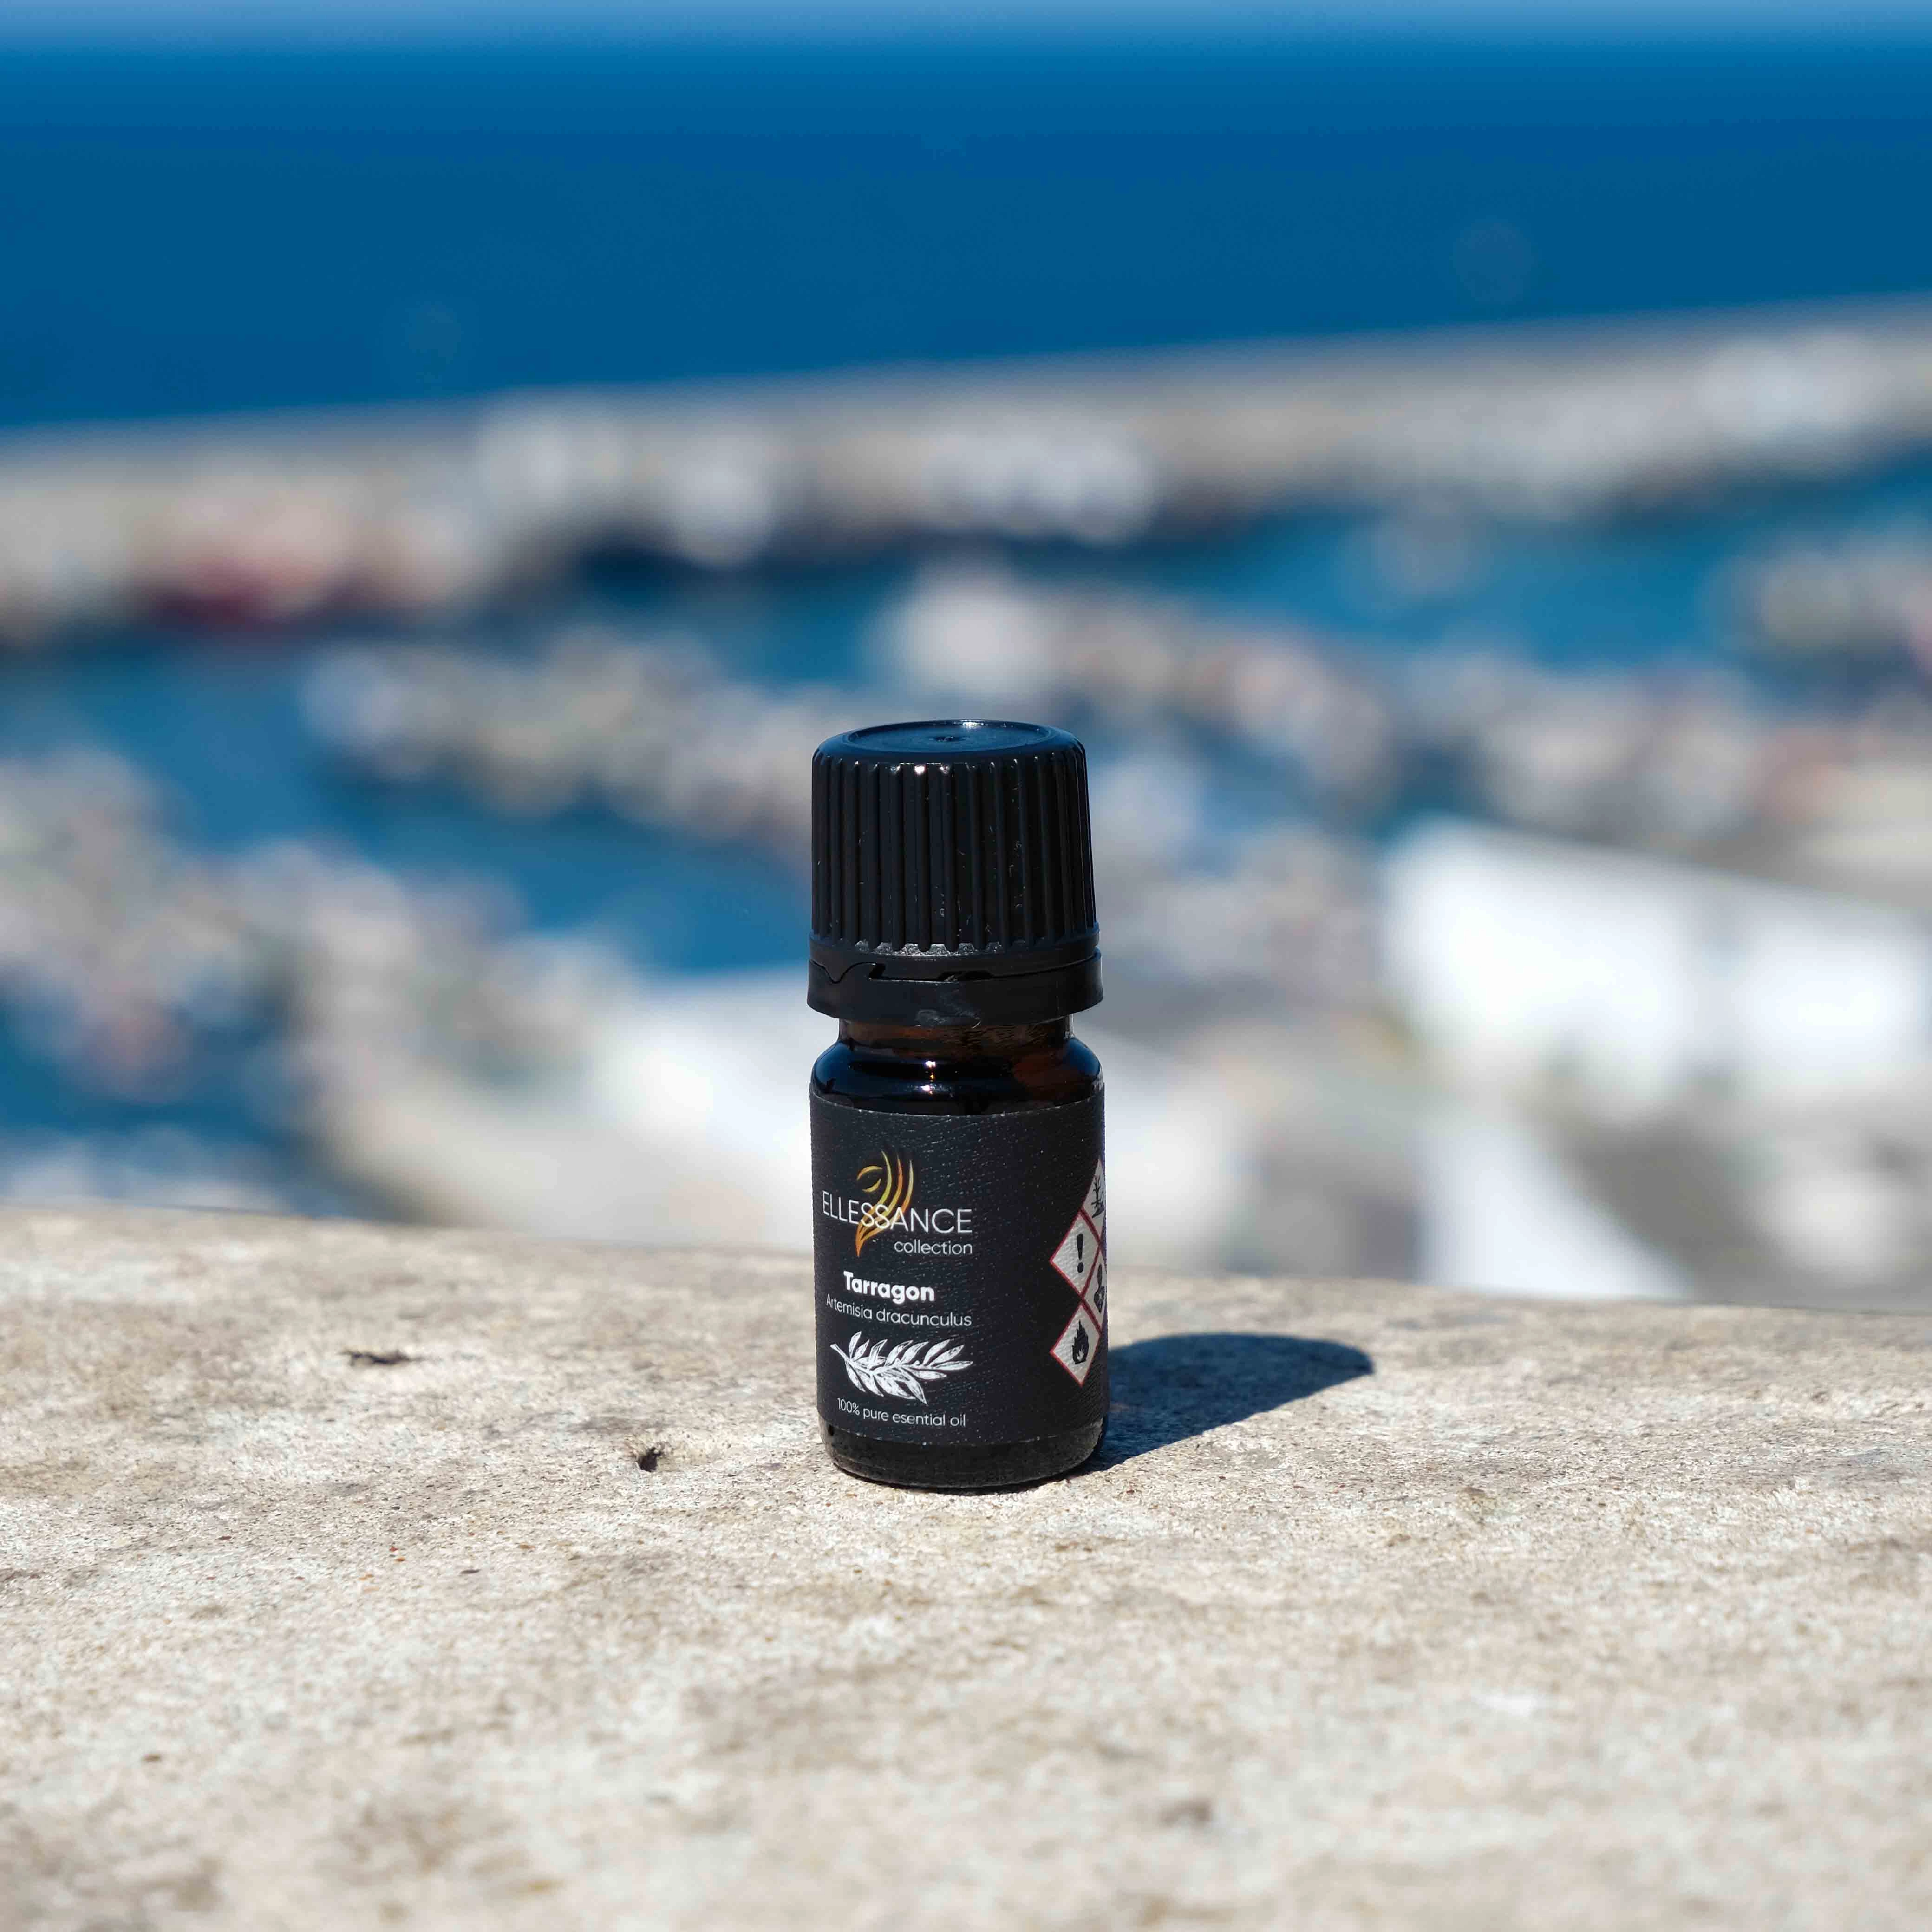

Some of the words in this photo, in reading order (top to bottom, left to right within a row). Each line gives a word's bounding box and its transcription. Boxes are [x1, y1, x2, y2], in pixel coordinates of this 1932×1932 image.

[822, 1190, 973, 1234] ELLESSANCE
[894, 1239, 973, 1255] collection
[843, 1271, 935, 1305] Tarragon
[826, 1293, 873, 1320] Artemisia
[876, 1308, 972, 1327] dracunculus
[837, 1397, 860, 1416] 100%
[863, 1407, 889, 1422] pure
[893, 1412, 946, 1427] esential
[950, 1415, 966, 1427] oil
